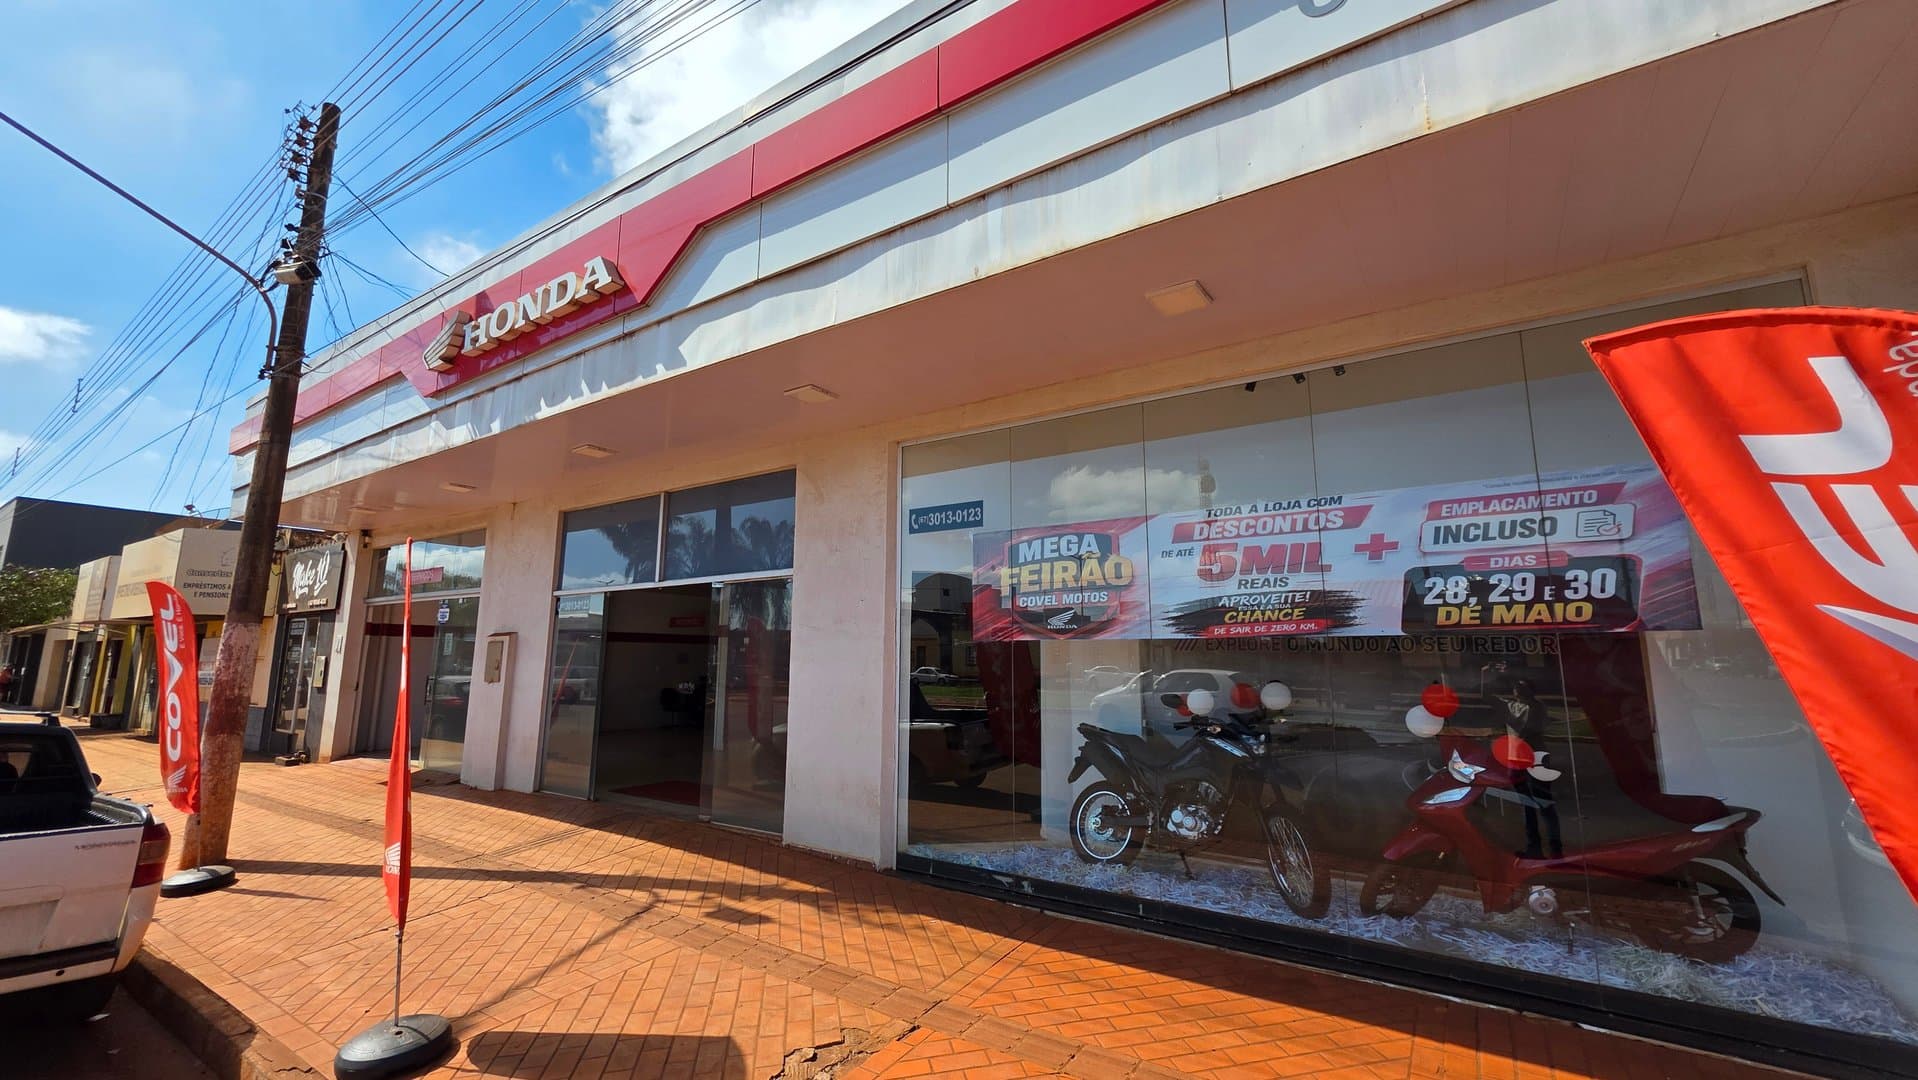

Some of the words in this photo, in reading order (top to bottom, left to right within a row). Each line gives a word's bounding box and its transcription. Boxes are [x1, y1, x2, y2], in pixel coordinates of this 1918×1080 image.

[461, 256, 613, 353] HONDA
[1206, 506, 1242, 518] TODA
[1248, 504, 1259, 514] A
[1264, 500, 1302, 512] LOJA
[1307, 496, 1343, 508] COM
[1441, 490, 1597, 517] EMPLACAMENTO
[1193, 510, 1344, 540] DESCONTOS
[1433, 517, 1558, 545] INCLUSO
[1018, 534, 1100, 563] MEGA
[1161, 550, 1174, 559] DE
[1176, 547, 1194, 558] ATÉ
[1490, 555, 1537, 568] DIAS
[999, 552, 1133, 597] FEIRÃO
[1237, 577, 1290, 590] REAIS
[1488, 572, 1535, 602] 29
[1544, 586, 1556, 600] E
[1564, 568, 1616, 599] 30
[1019, 594, 1058, 607] COVEL
[1062, 591, 1109, 605] MOTOS
[1218, 591, 1311, 607] APROVEITE!
[1224, 608, 1307, 624] CHANCE
[1437, 604, 1482, 626] DE
[1492, 601, 1593, 625] MAIO
[1214, 626, 1227, 635] DE
[1230, 625, 1252, 634] SAIR
[1254, 624, 1268, 633] DE
[1271, 623, 1297, 632] ZERO
[1421, 635, 1468, 653] SEU
[1472, 634, 1558, 654] REDOR
[160, 593, 184, 762] COVEL
